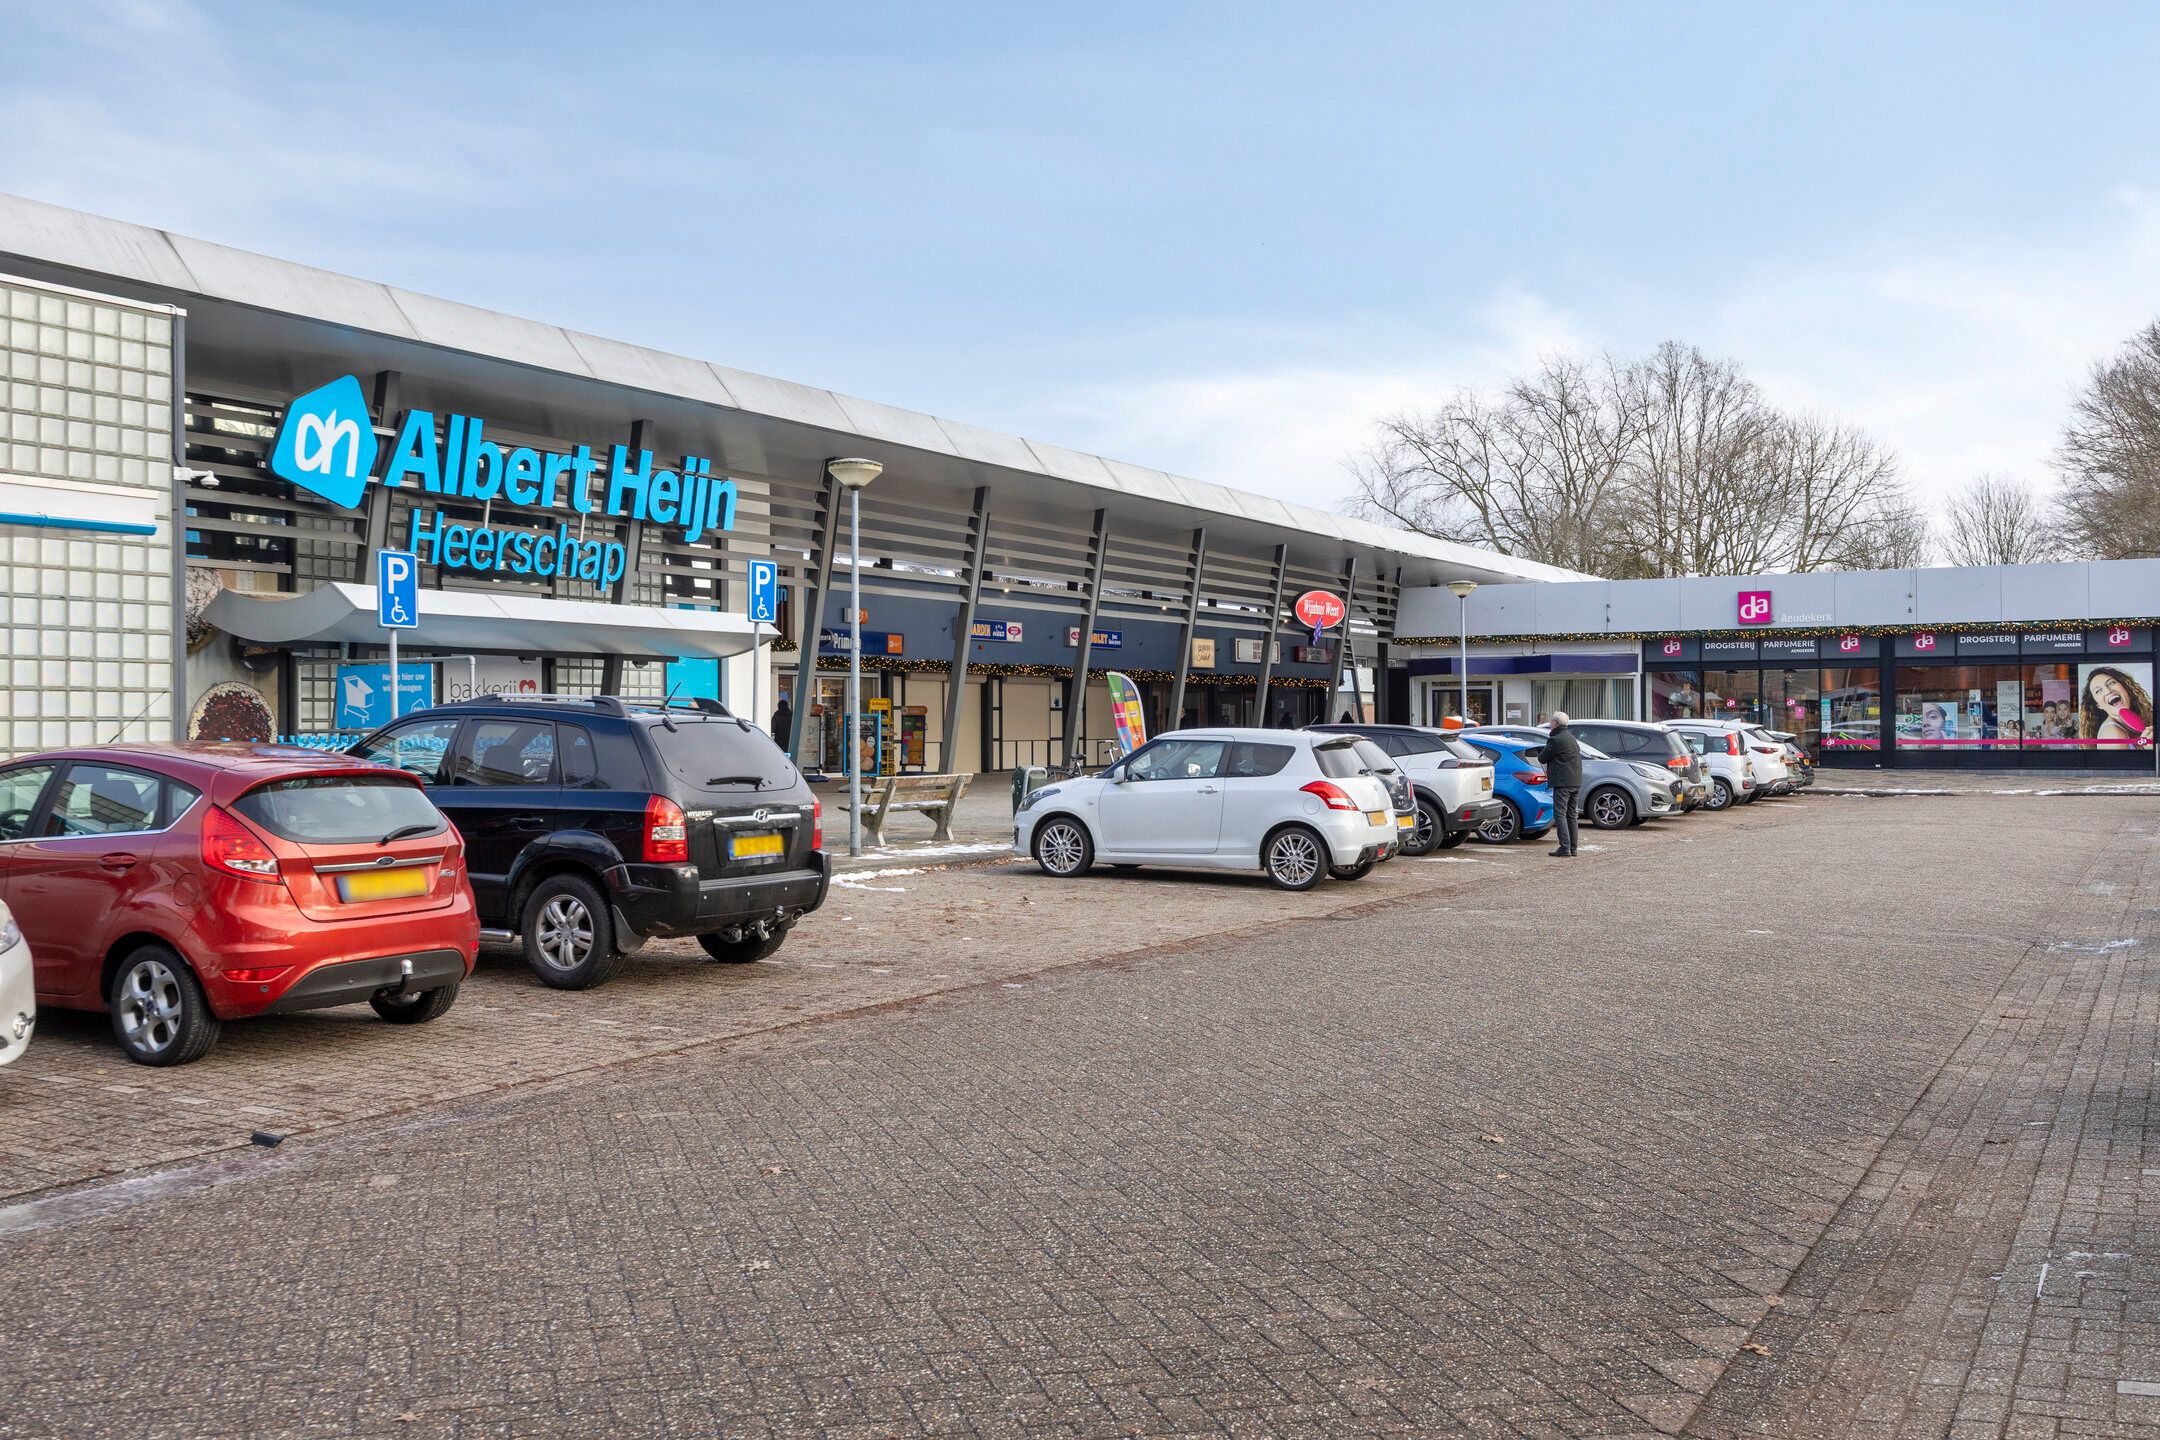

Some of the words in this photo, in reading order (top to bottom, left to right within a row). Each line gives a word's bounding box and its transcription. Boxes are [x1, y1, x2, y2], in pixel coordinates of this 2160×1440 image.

[384, 409, 597, 514] Albert
[605, 443, 738, 542] Heijn
[409, 508, 627, 592] Heerschap
[388, 556, 409, 594] P
[755, 565, 771, 595] P
[1740, 595, 1769, 619] da
[1780, 612, 1833, 624] Aendekerk
[1840, 636, 1859, 650] da
[1915, 633, 1934, 648] da
[1960, 635, 2016, 645] DROGISTERIJ
[2024, 633, 2082, 642] PARFUMERIE
[2109, 628, 2129, 644] da
[1663, 640, 1680, 654] da
[1704, 641, 1755, 650] DROGISTERIJ
[1763, 640, 1815, 648] PARFUMERIE
[401, 672, 414, 681] hier
